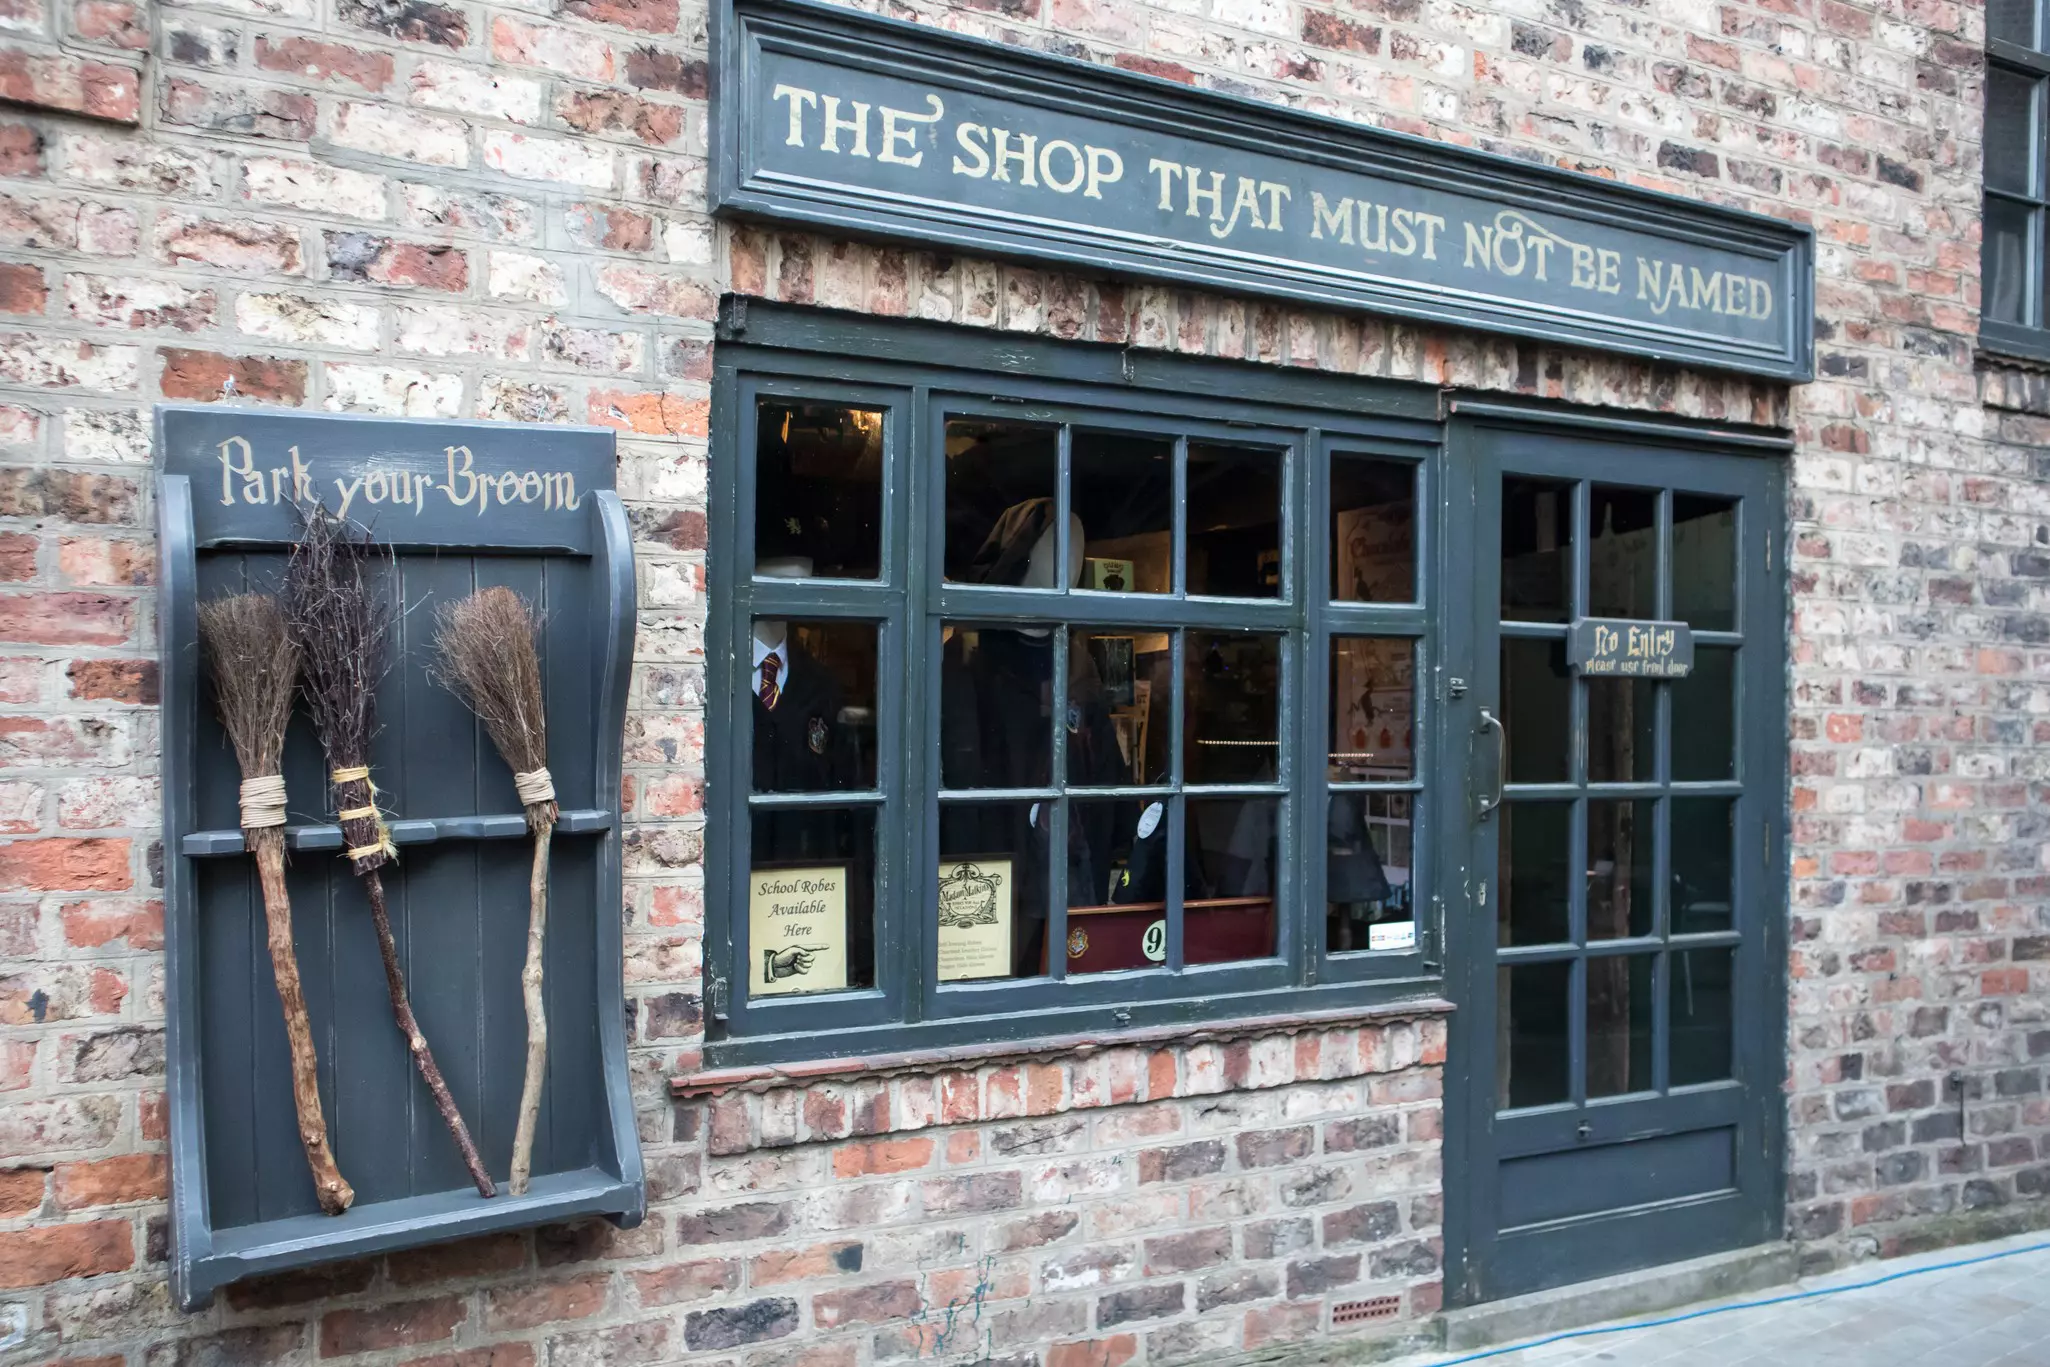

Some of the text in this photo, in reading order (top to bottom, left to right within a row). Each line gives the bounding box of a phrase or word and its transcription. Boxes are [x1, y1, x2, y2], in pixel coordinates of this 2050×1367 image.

[773, 83, 1773, 321] THE SHOP THAT MUST NOT BE NAMED
[215, 434, 582, 524] Park your Broom
[1594, 624, 1675, 659] No Entry
[1620, 659, 1639, 674] use
[1667, 658, 1688, 676] door
[758, 877, 836, 896] School Robes
[767, 899, 827, 919] Available
[783, 923, 812, 937] Here
